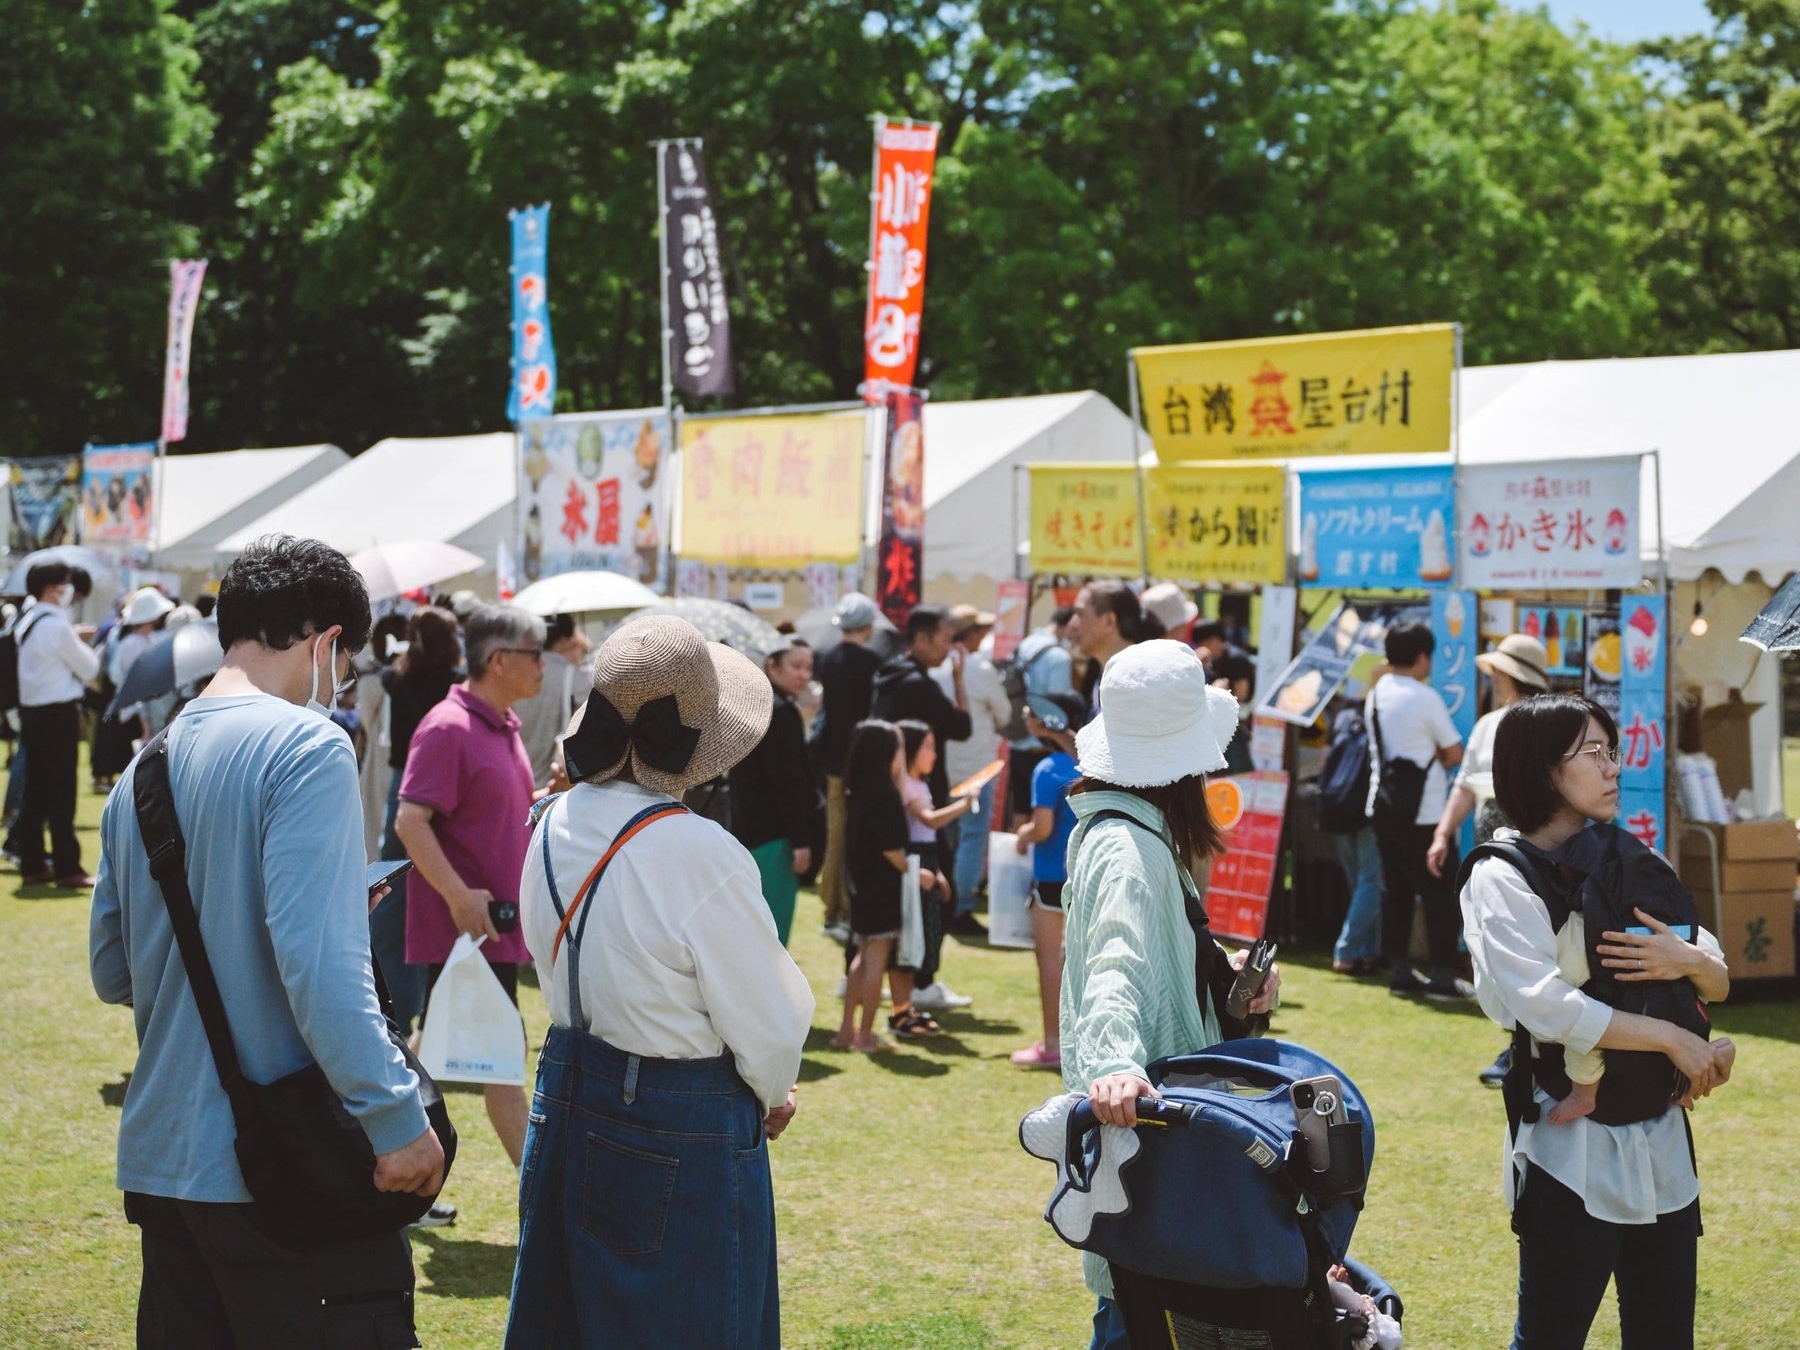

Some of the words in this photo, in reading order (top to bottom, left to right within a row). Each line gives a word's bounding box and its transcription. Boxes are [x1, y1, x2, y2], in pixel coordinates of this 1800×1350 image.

[1163, 382, 1236, 435] 台湾
[1300, 369, 1412, 428] 屋台村
[1318, 504, 1425, 536] ソフトクリーム
[1496, 507, 1596, 552] かき氷
